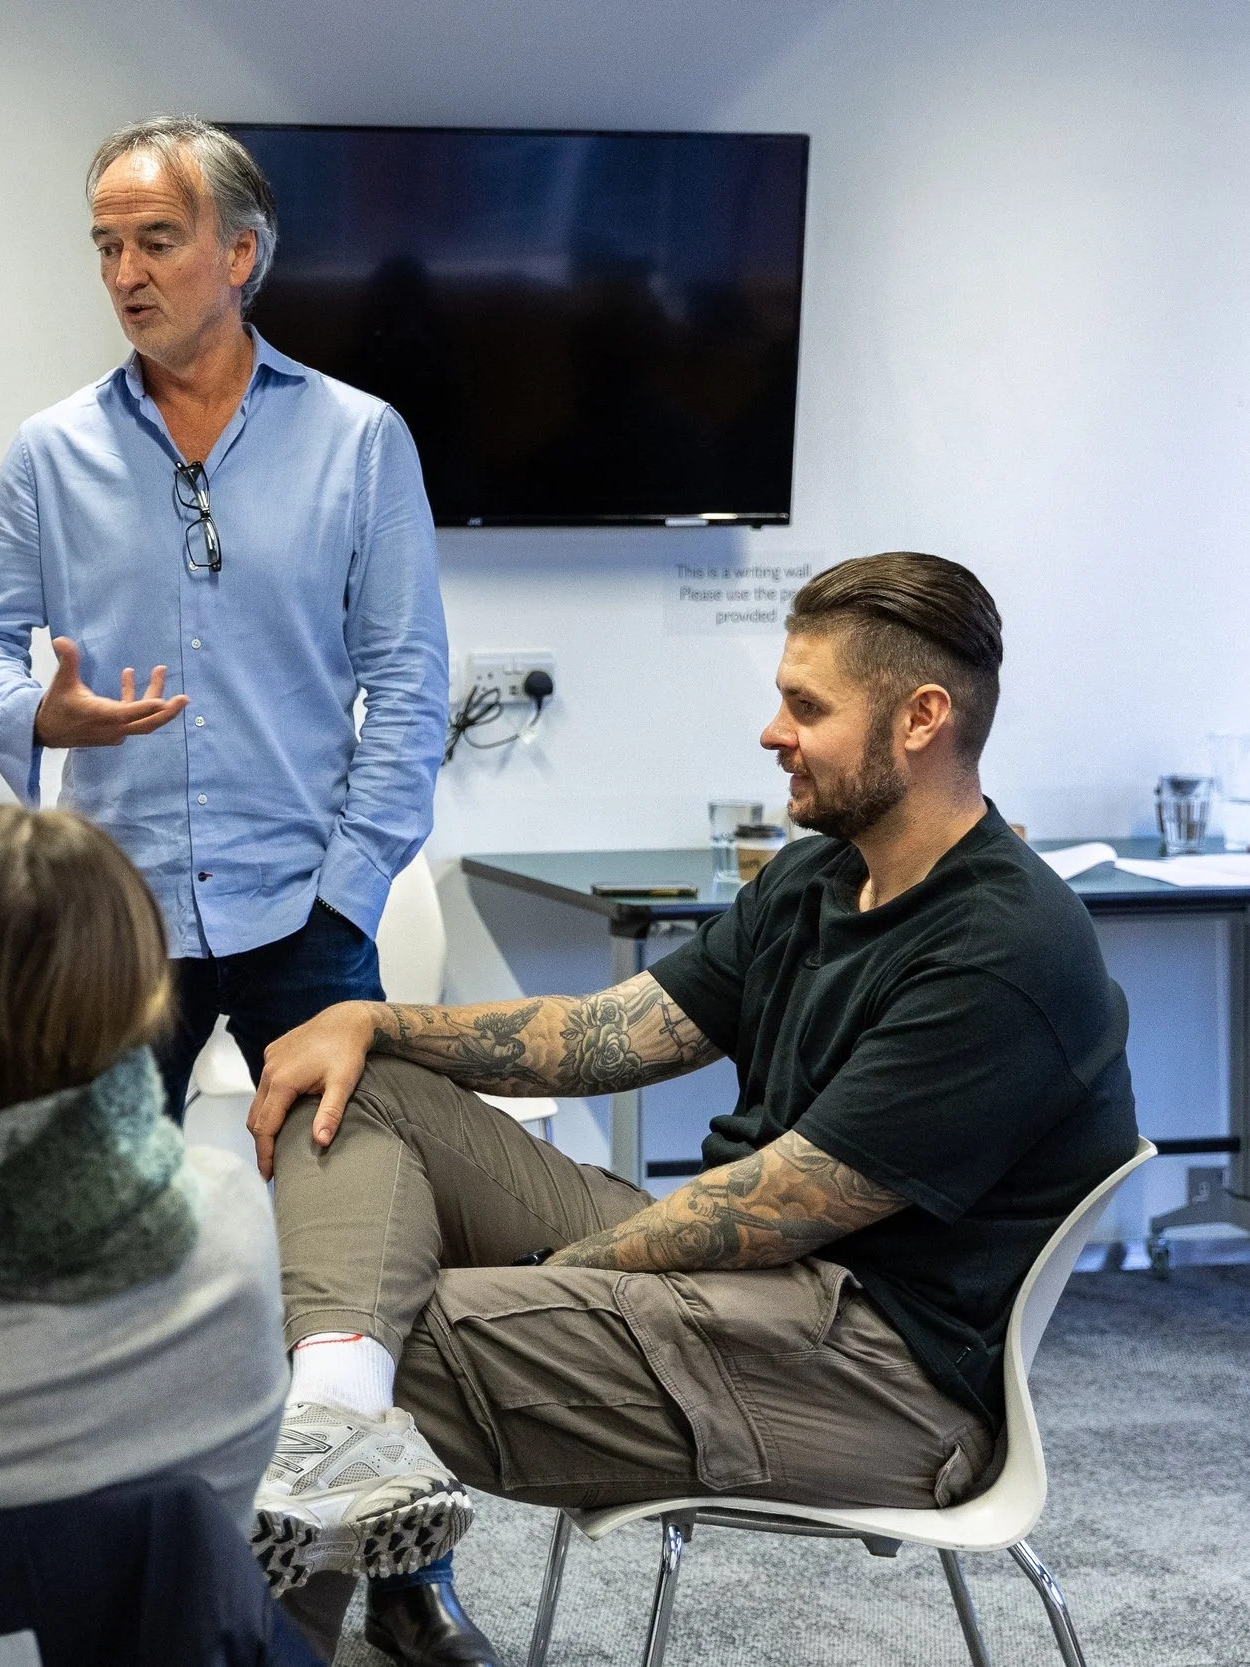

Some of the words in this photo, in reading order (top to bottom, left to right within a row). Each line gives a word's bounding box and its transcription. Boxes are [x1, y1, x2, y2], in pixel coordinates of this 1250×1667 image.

[676, 564, 704, 579] This
[707, 565, 717, 579] is
[722, 567, 730, 579] a
[734, 564, 780, 583] writing
[784, 564, 810, 579] wall
[679, 587, 722, 601] Please
[726, 590, 750, 601] use
[754, 587, 776, 601] the
[716, 609, 776, 625] provided
